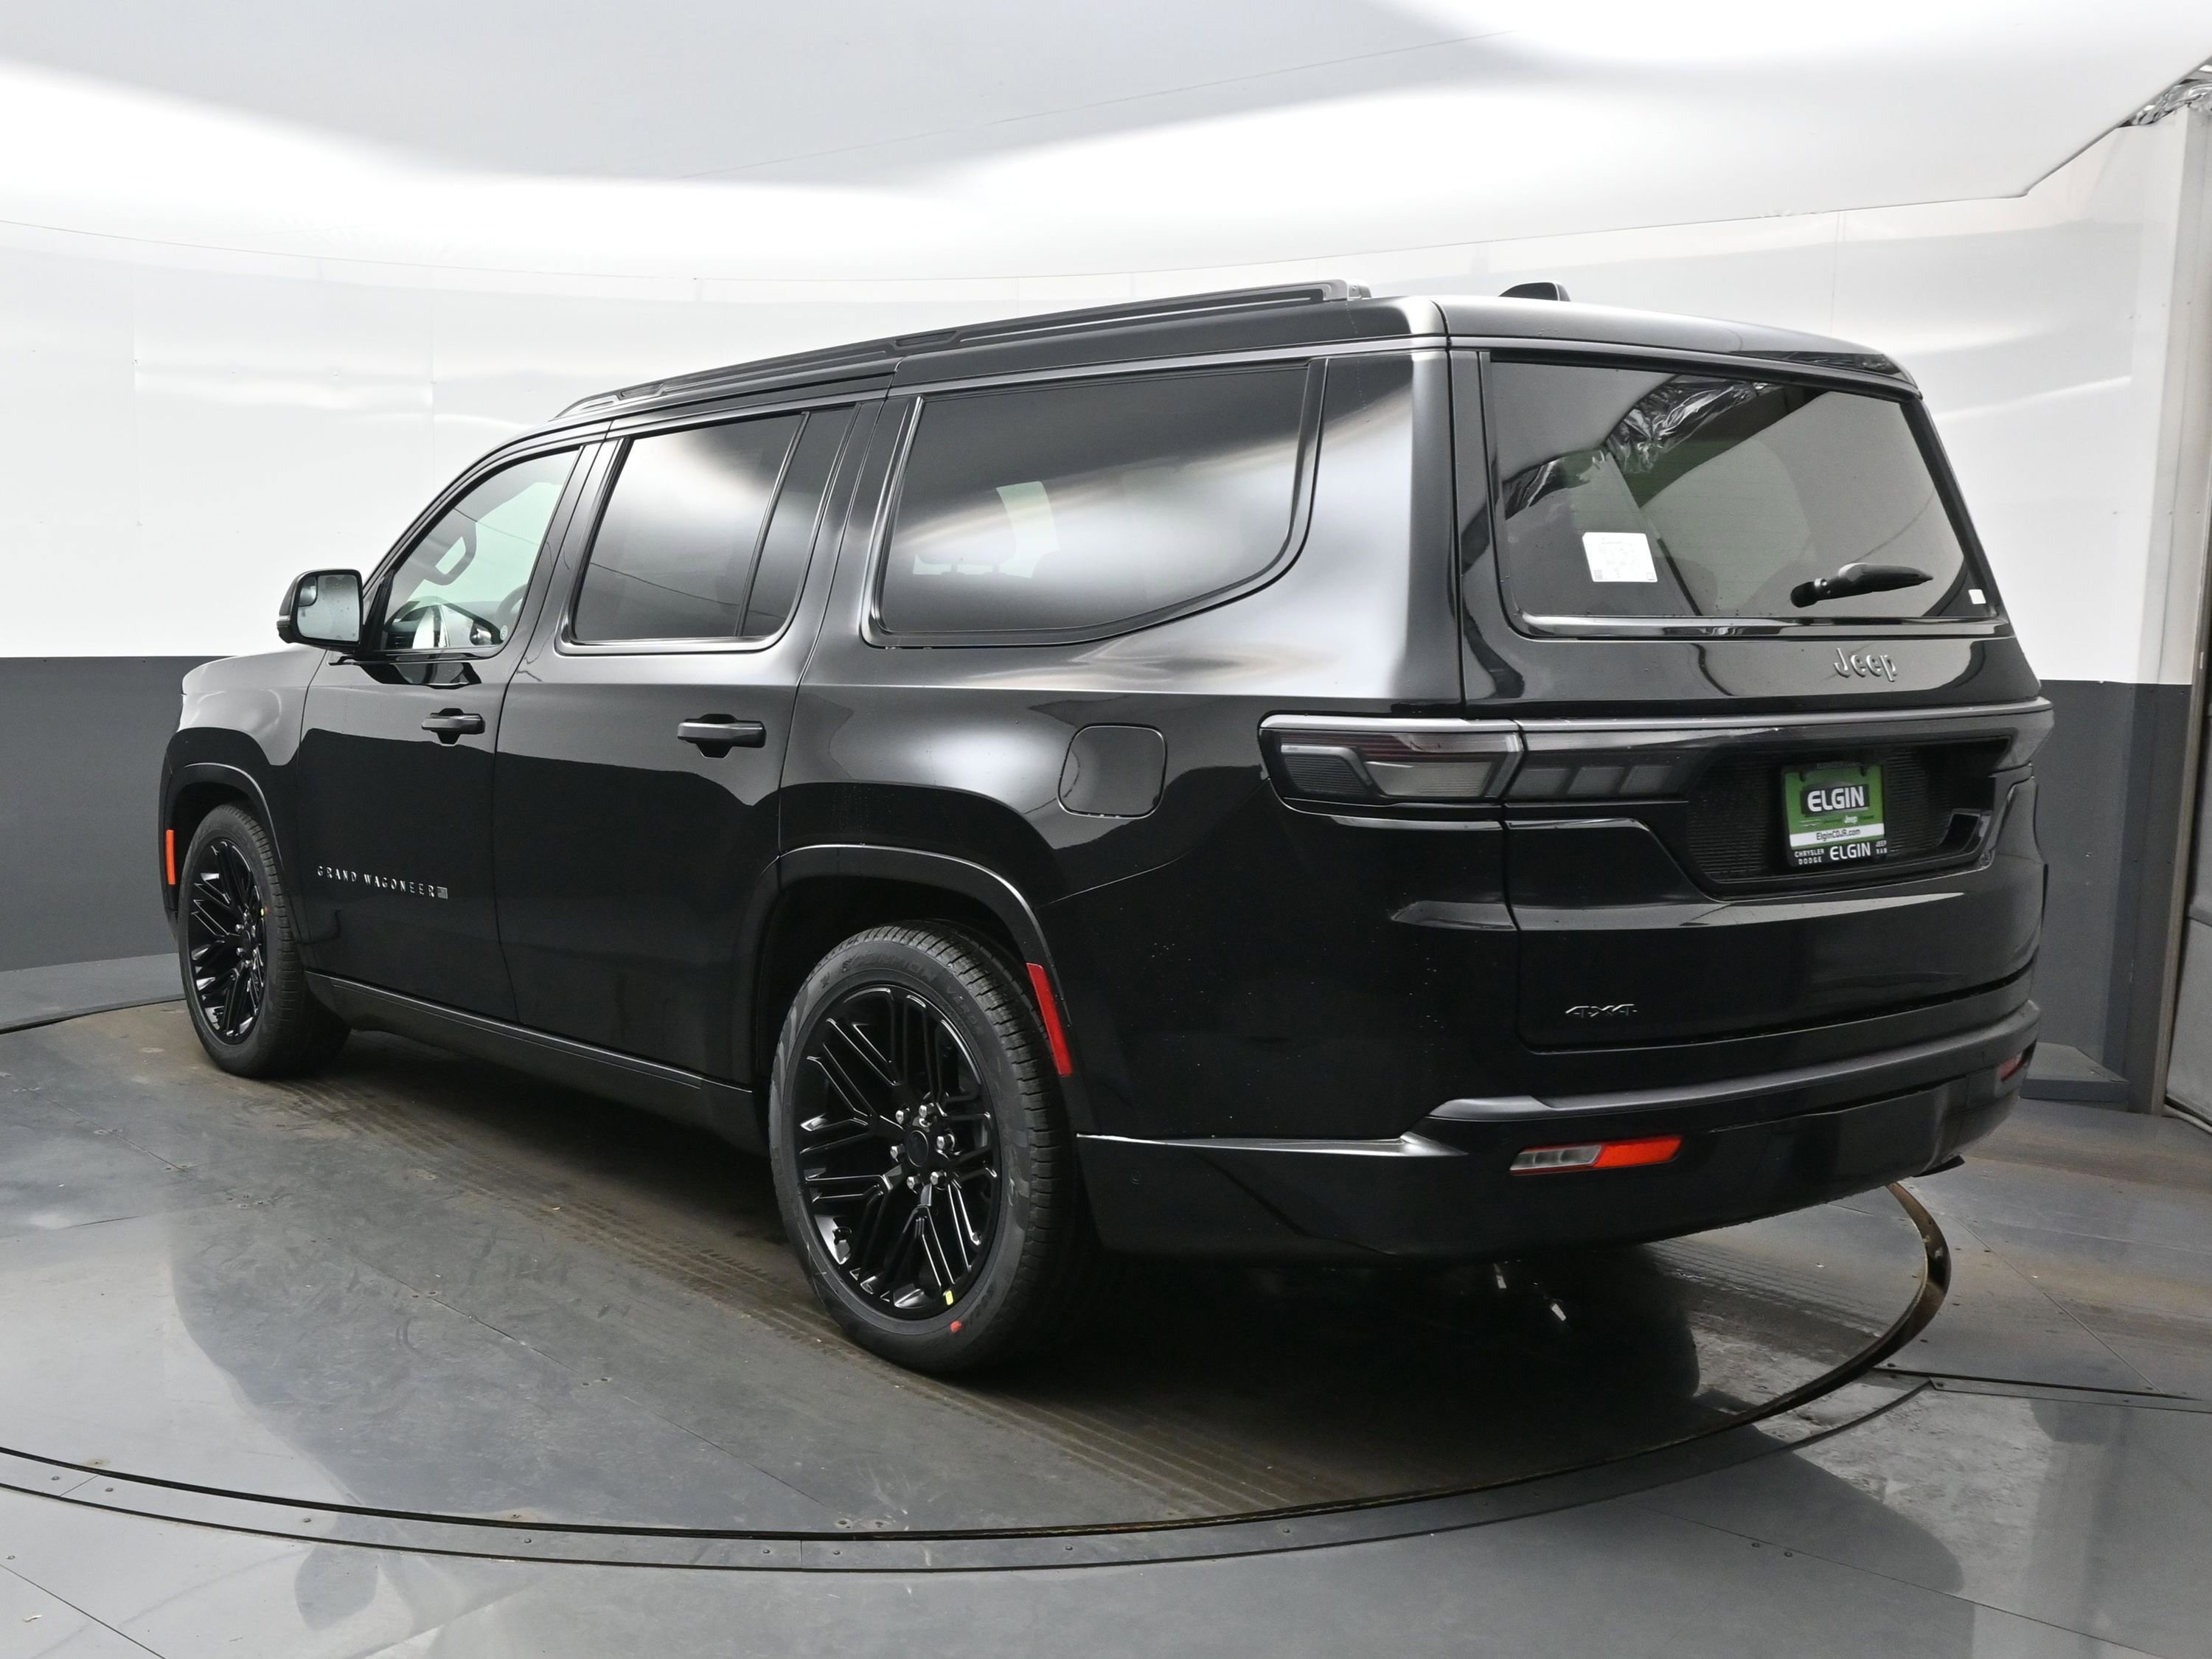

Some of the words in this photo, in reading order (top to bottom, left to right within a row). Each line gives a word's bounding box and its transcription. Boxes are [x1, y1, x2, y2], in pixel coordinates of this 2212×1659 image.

[1833, 647, 1897, 683] Jeep
[1807, 786, 1864, 813] ELGIN
[1794, 849, 1824, 858] CHRYSLER
[1798, 857, 1823, 865] DODGE
[1830, 842, 1871, 860] ELGIN
[317, 866, 357, 882] GRAND
[364, 873, 435, 898] WAGONEER
